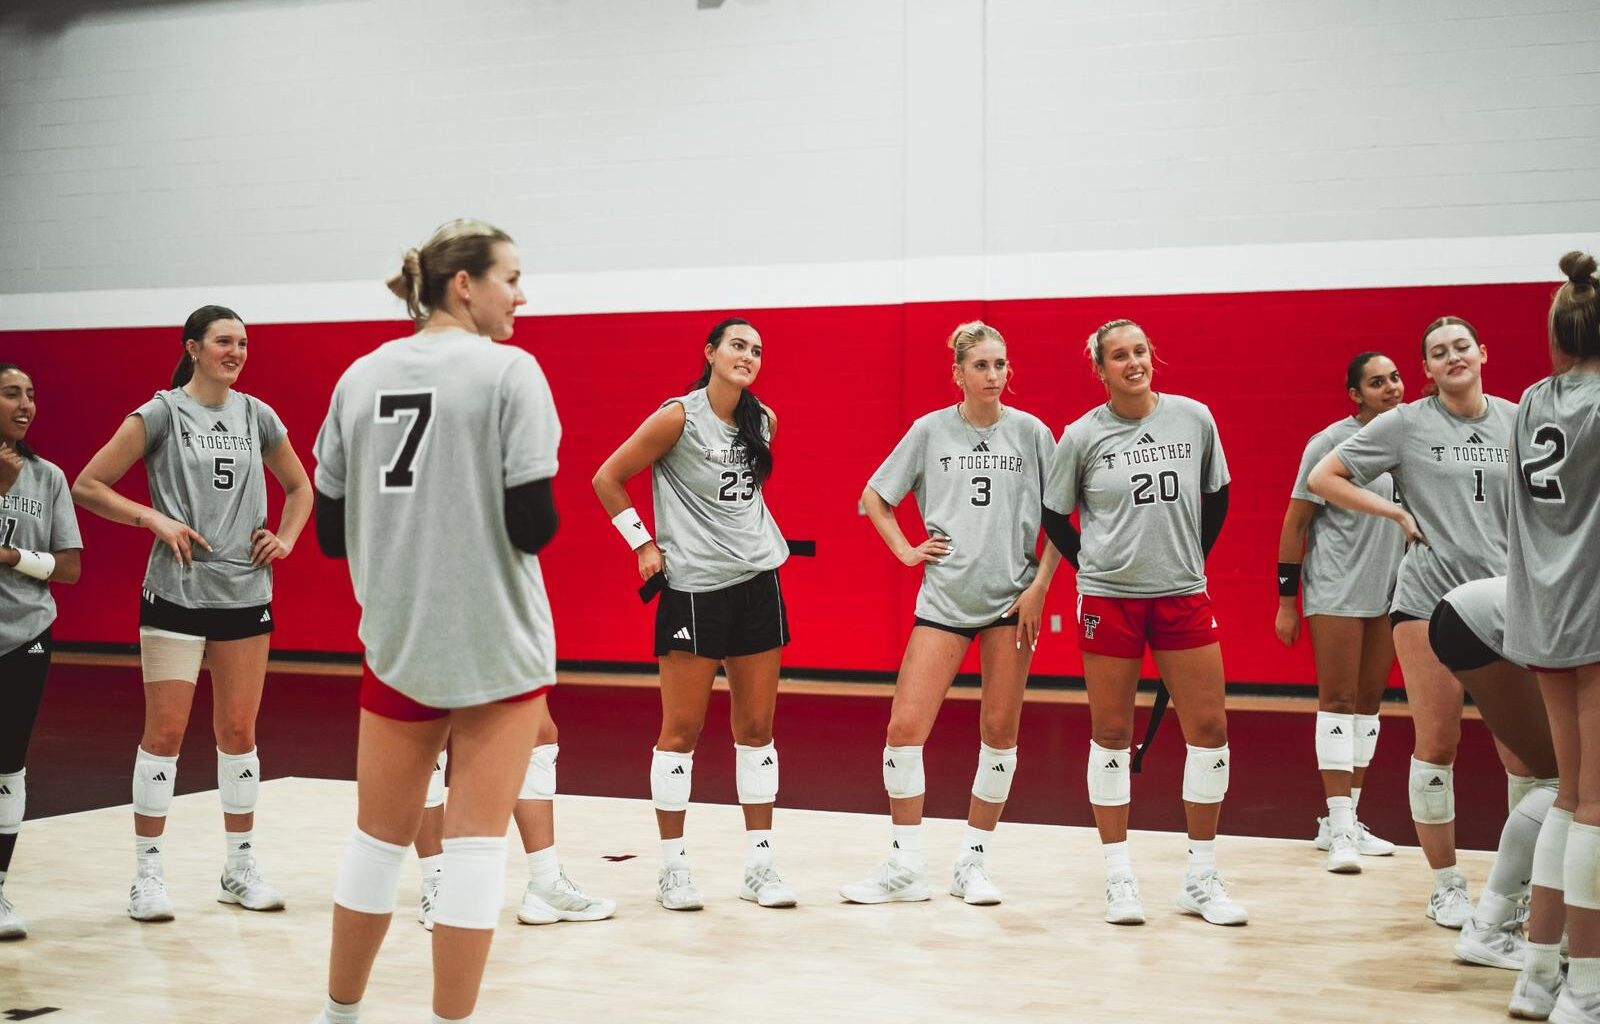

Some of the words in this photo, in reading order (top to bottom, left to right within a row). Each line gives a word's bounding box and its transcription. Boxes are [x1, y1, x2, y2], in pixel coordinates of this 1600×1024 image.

[198, 434, 252, 451] TOGETHE
[374, 387, 437, 493] 7
[1123, 443, 1192, 466] TOGETHER
[1453, 446, 1509, 463] TOGETHE
[212, 456, 235, 491] 5
[958, 455, 1023, 473] TOGETHER
[1521, 422, 1567, 504] 2
[718, 468, 756, 502] 23
[970, 475, 992, 508] 3
[1130, 469, 1180, 508] 20
[1472, 467, 1487, 504] 1
[1, 495, 44, 520] ETHER
[0, 516, 17, 548] 1
